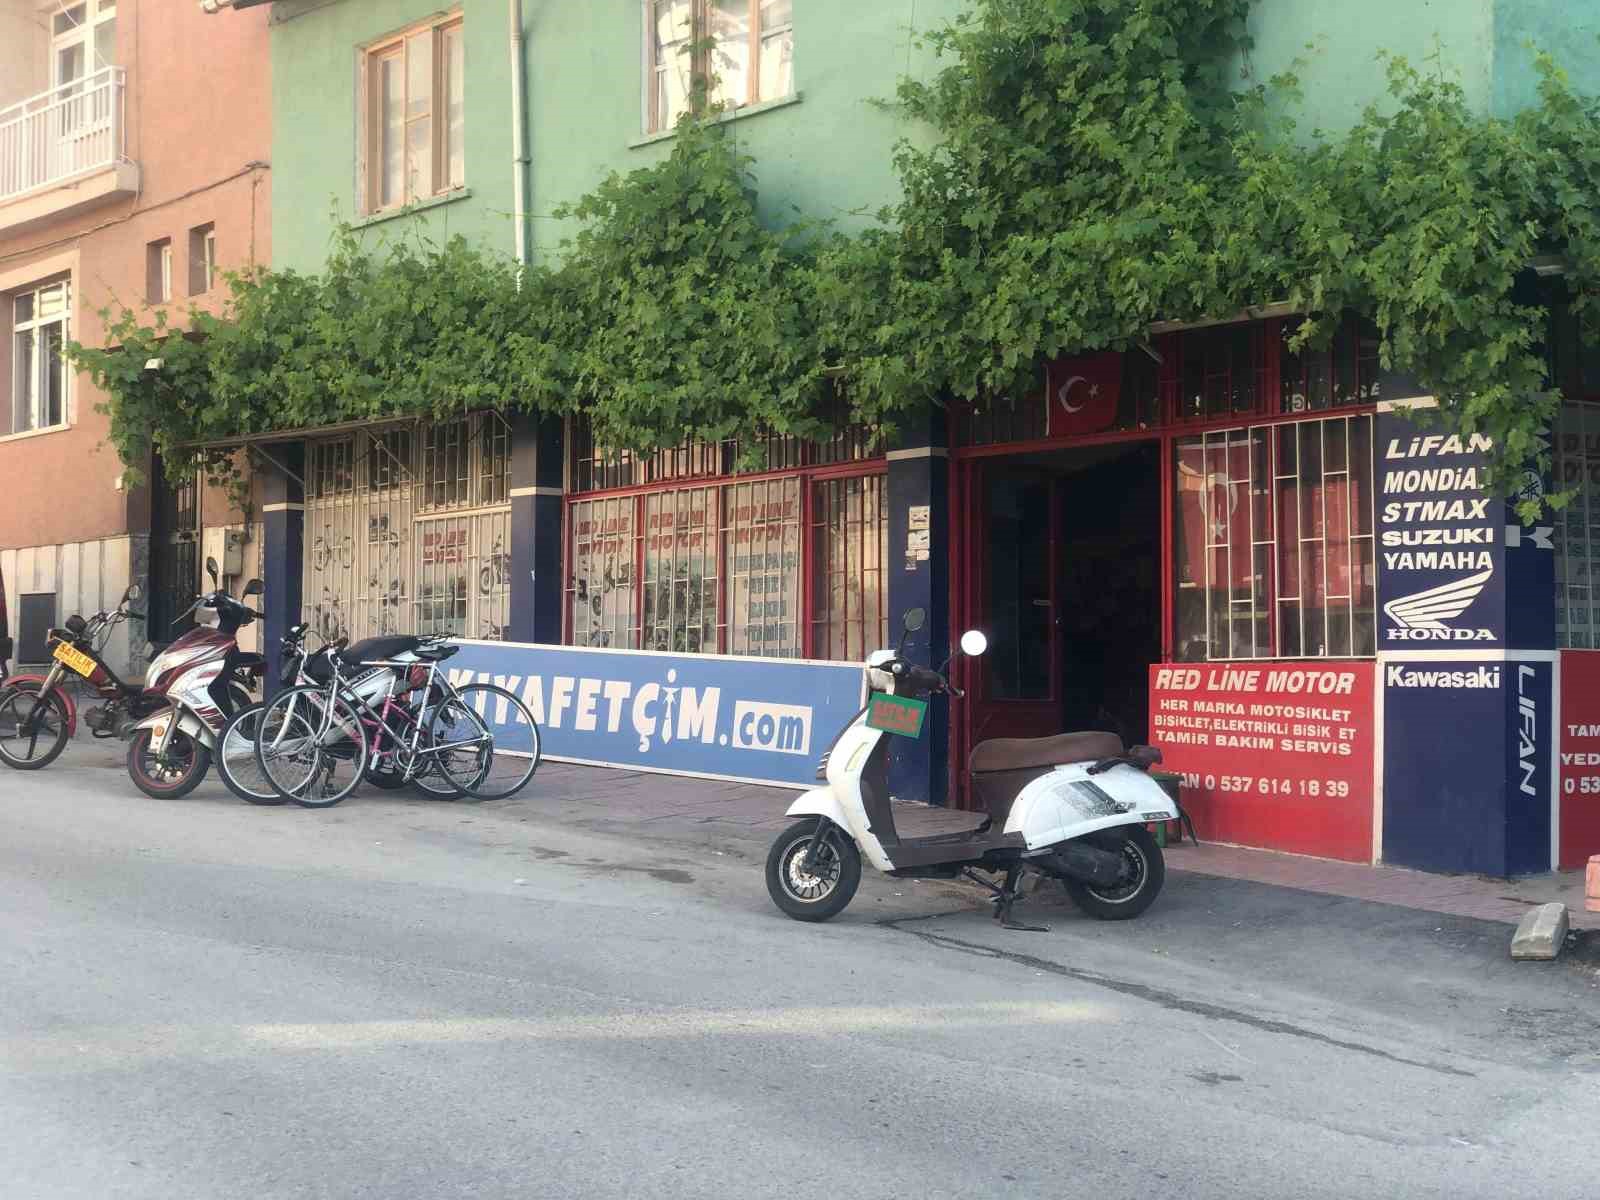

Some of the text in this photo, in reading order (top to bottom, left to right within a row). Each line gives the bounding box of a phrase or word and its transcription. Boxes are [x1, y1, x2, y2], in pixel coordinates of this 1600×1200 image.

[1382, 498, 1491, 523] STMAX
[1382, 527, 1494, 547] SUZUKI
[1383, 551, 1494, 570] YAMAHA
[1386, 628, 1498, 641] HONDA
[1155, 669, 1201, 691] RED
[1265, 671, 1356, 694] MOTOR
[1387, 665, 1500, 689] Kawasaki
[1160, 699, 1189, 711] HER
[1193, 701, 1246, 716] MARKA
[1518, 664, 1537, 796] LIFAN
[1567, 724, 1600, 737] TAM
[1215, 735, 1274, 750] BAKIM
[1560, 753, 1600, 766] YED
[1205, 774, 1216, 790] 0
[1220, 775, 1253, 792] 537
[1258, 778, 1292, 795] 614
[1326, 780, 1349, 797] 39
[1564, 776, 1600, 793] 0 53
